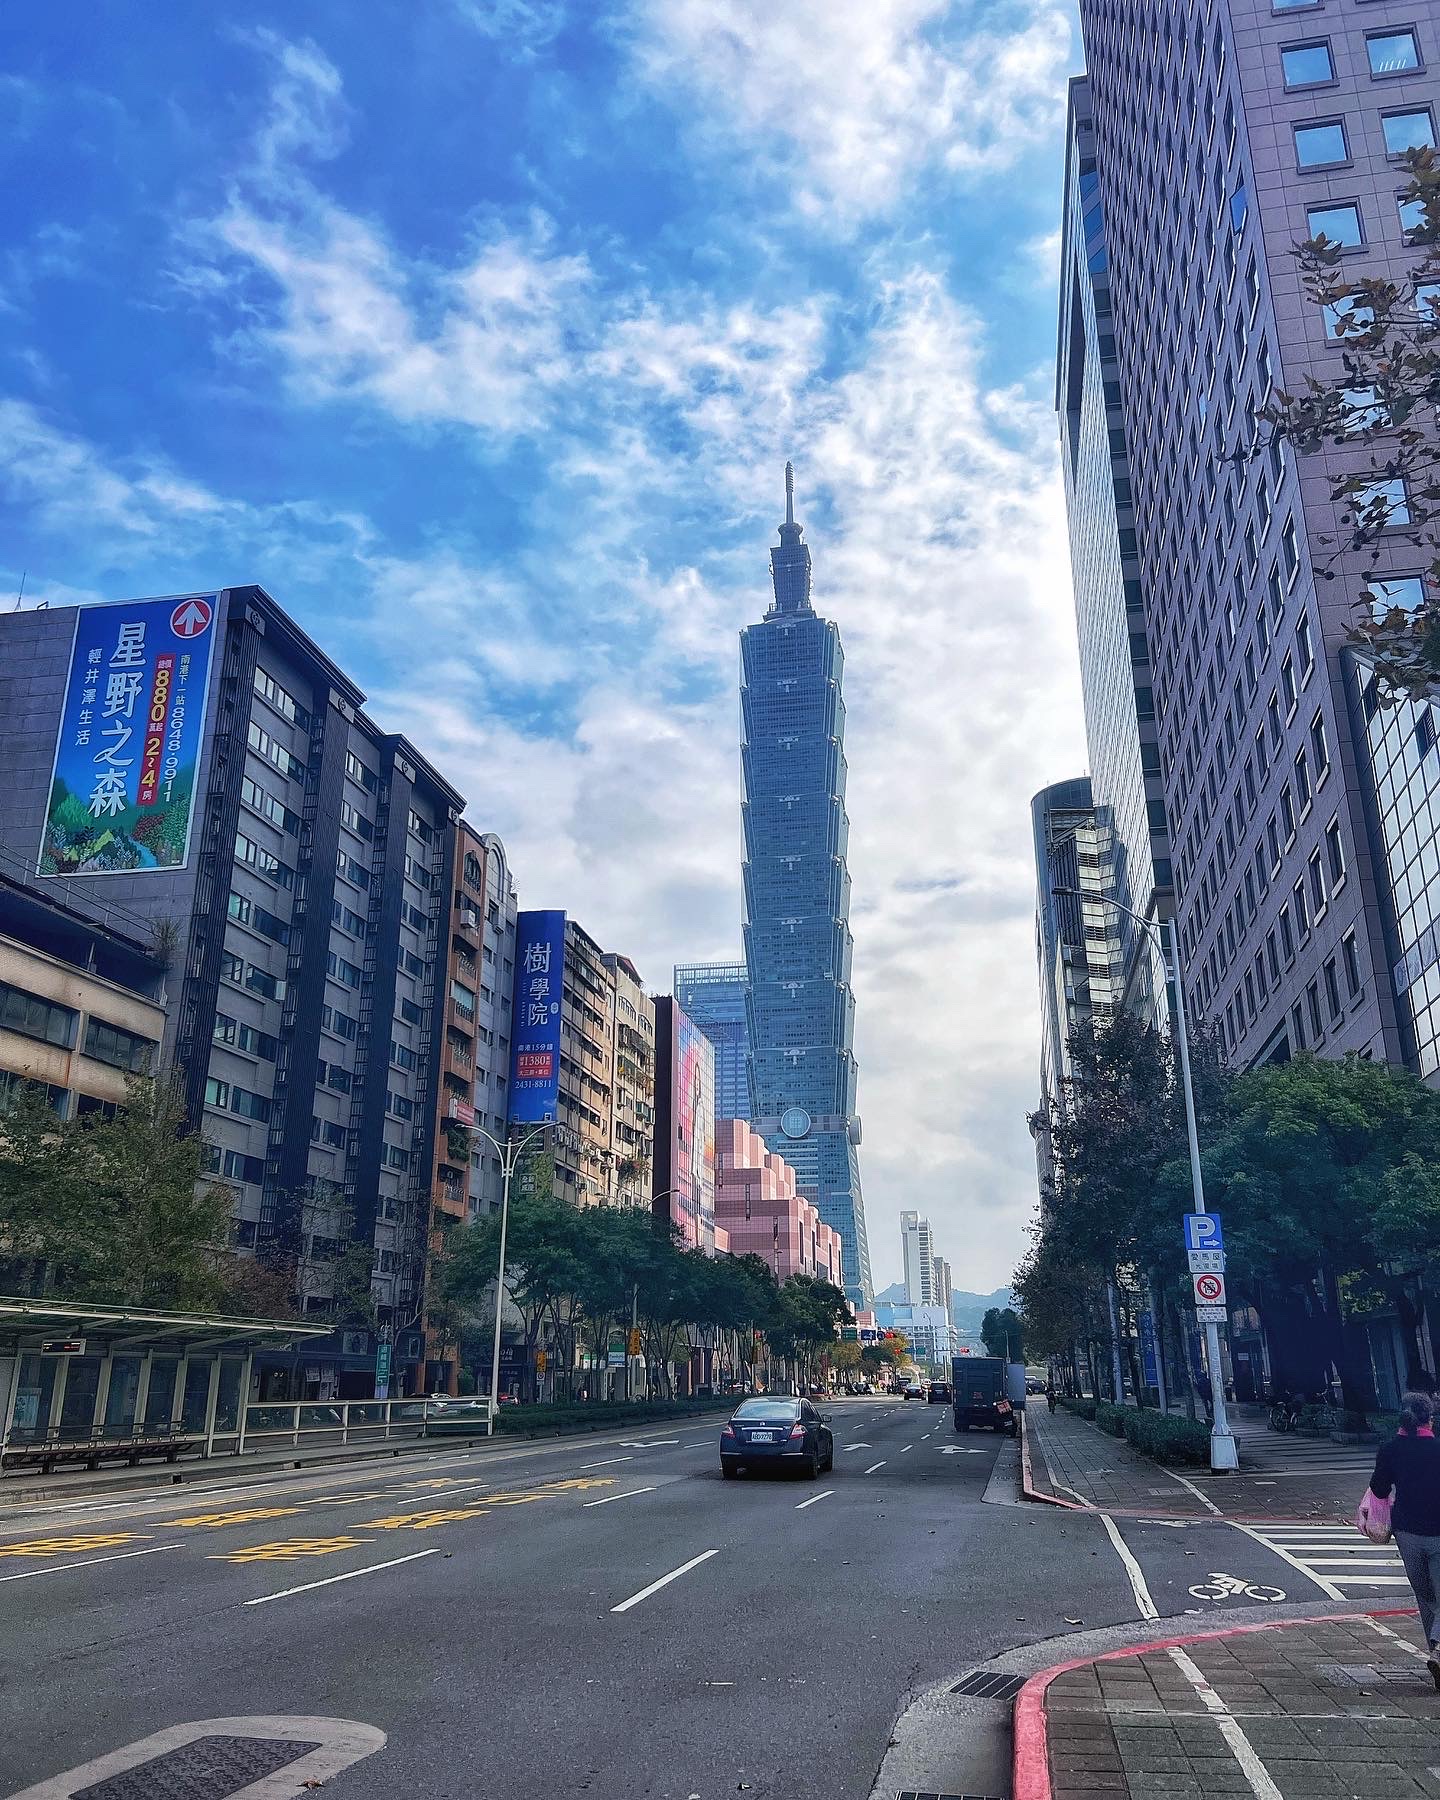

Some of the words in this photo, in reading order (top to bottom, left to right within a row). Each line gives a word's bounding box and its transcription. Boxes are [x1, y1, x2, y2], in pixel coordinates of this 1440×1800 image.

[74, 648, 103, 747] 輕井澤生活
[88, 621, 147, 818] 星野之森
[523, 942, 552, 1026] 樹學院
[514, 1079, 551, 1089] 2431-8811
[1189, 1216, 1216, 1249] P
